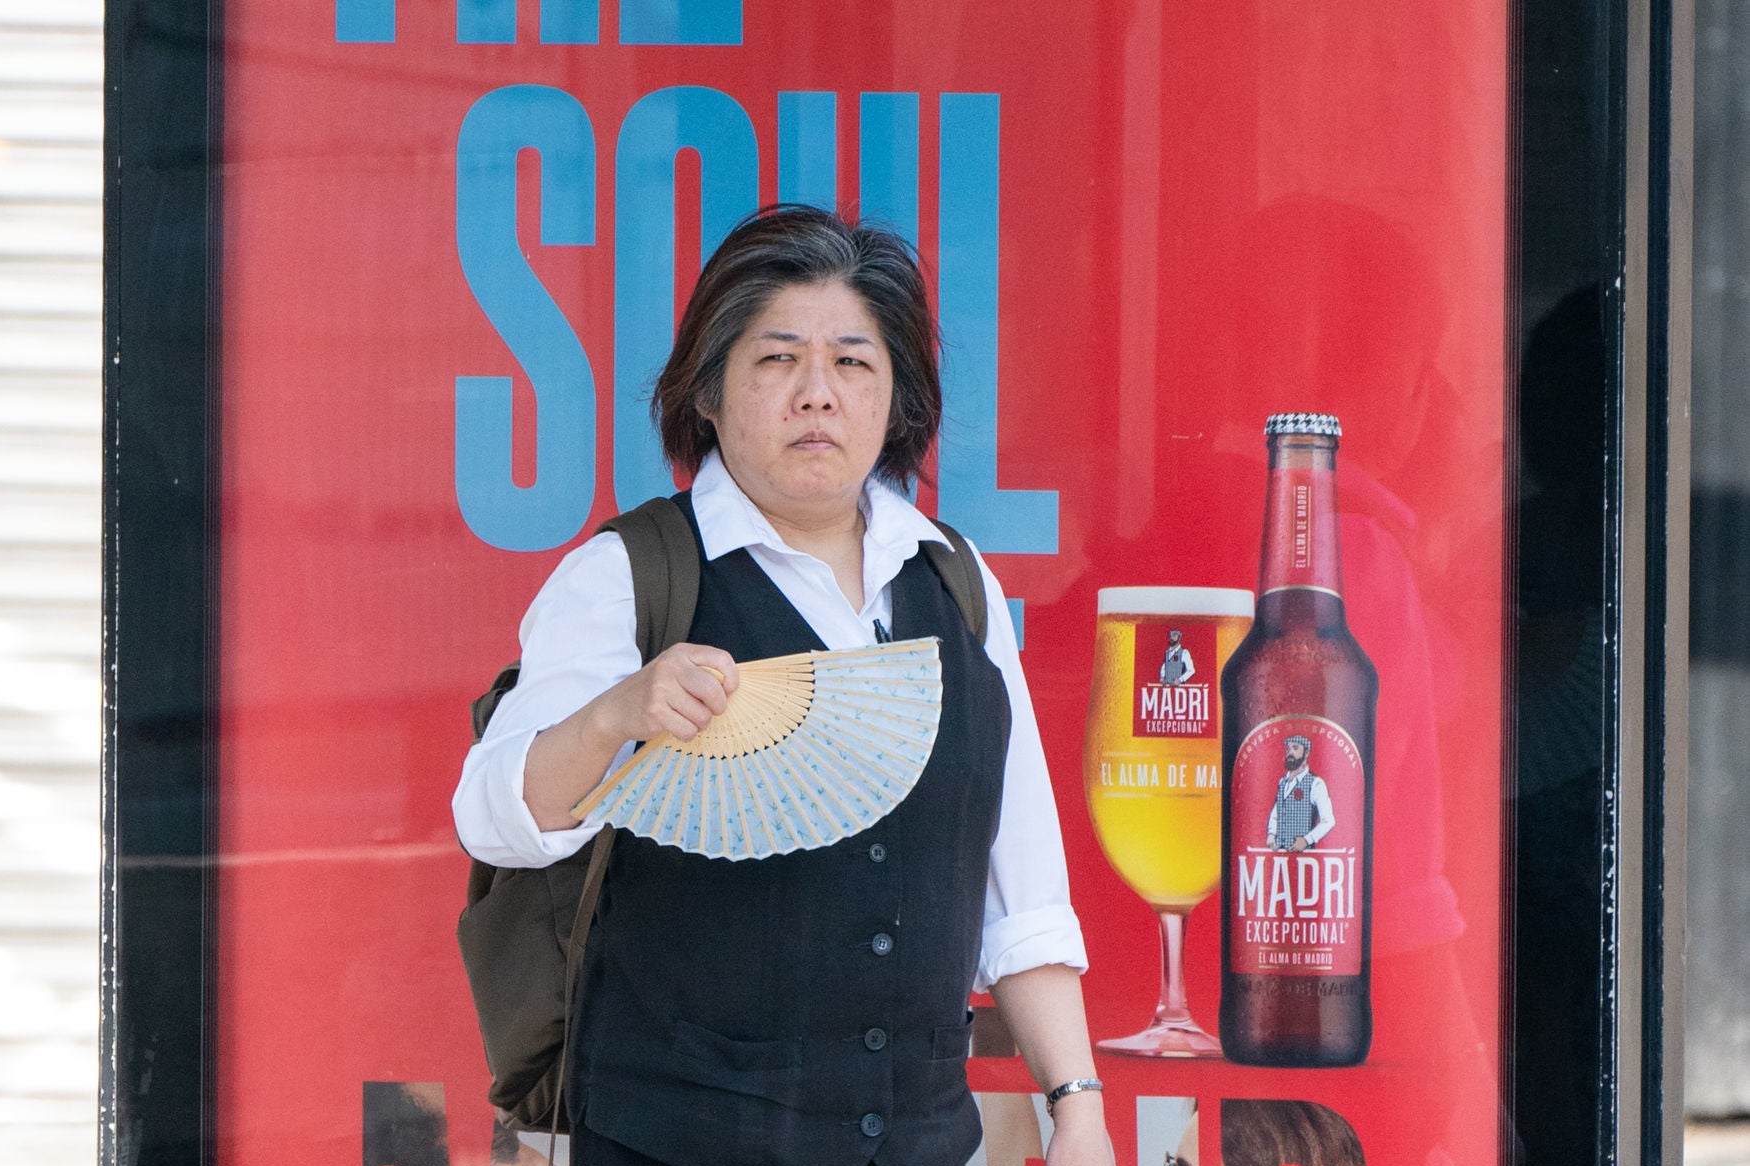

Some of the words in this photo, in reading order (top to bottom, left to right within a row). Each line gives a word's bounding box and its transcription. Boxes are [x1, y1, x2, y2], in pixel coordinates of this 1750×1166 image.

[1297, 486, 1307, 517] MADRID
[1296, 521, 1307, 530] DE
[1296, 533, 1306, 555] ALMA
[1296, 559, 1306, 569] EL
[1146, 720, 1203, 734] EXCEPCIONAL
[1239, 727, 1280, 768] CERVEZA
[1101, 763, 1114, 787] EL
[1119, 763, 1160, 788] ALMA
[1168, 764, 1187, 789] DE
[1246, 920, 1346, 944] EXCEPCIONAL
[1258, 952, 1266, 964] EL
[1269, 952, 1289, 964] ALMA
[1292, 952, 1301, 964] DE
[1305, 952, 1333, 965] MADRID
